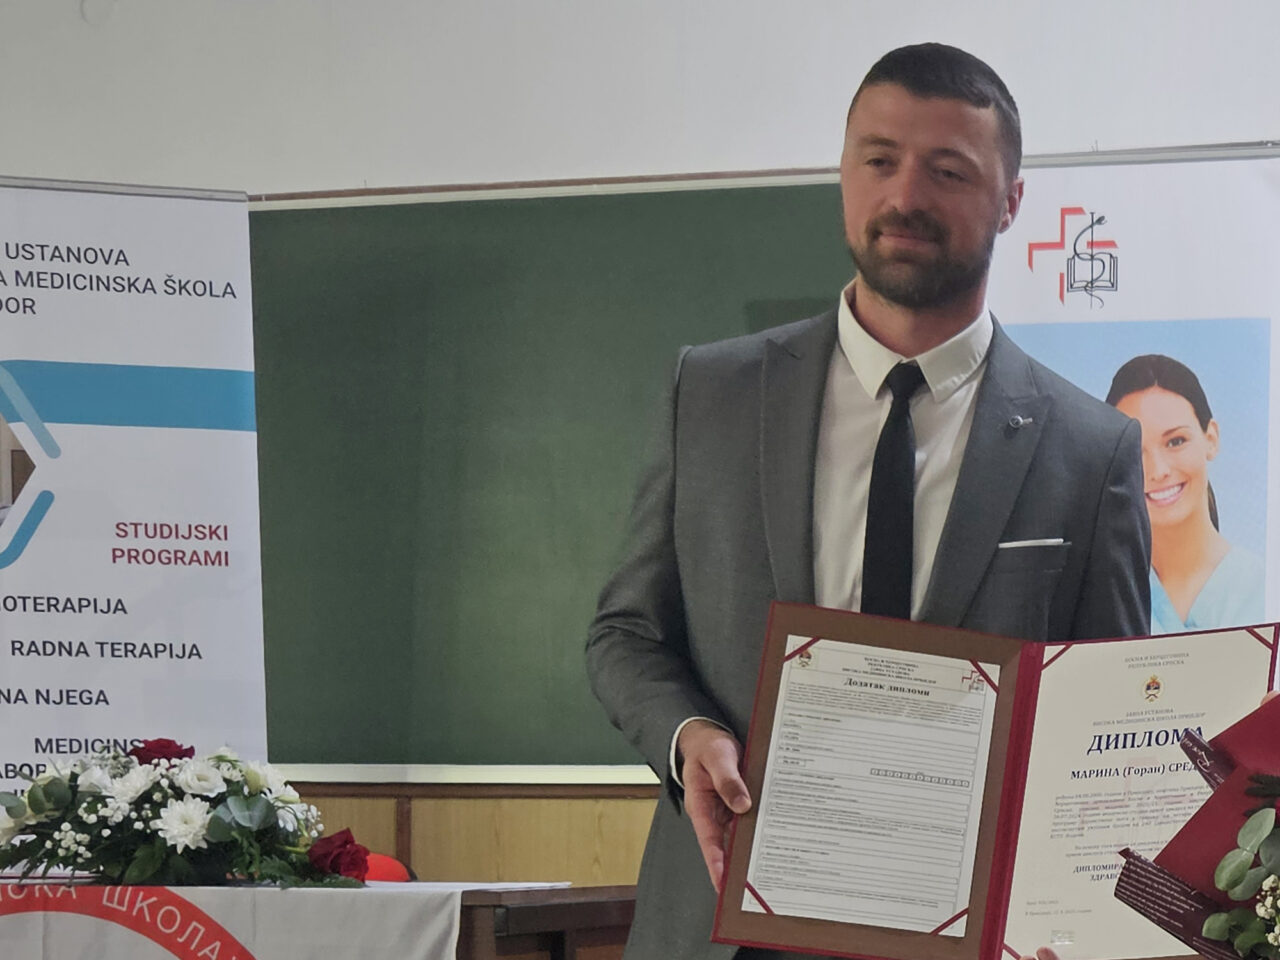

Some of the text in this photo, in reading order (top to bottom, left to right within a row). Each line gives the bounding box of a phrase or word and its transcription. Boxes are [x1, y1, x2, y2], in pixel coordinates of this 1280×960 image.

[5, 242, 130, 266] USTANOVA
[14, 270, 157, 295] MEDICINSKA
[163, 274, 237, 299] ŠKOLA
[115, 522, 228, 541] STUDIJSKI
[112, 548, 229, 567] PROGRAMI
[11, 639, 203, 660] RADNA TERAPIJA
[35, 689, 110, 706] NJEGA
[1070, 766, 1120, 780] МАРИНА
[1122, 762, 1165, 779] (Горан)
